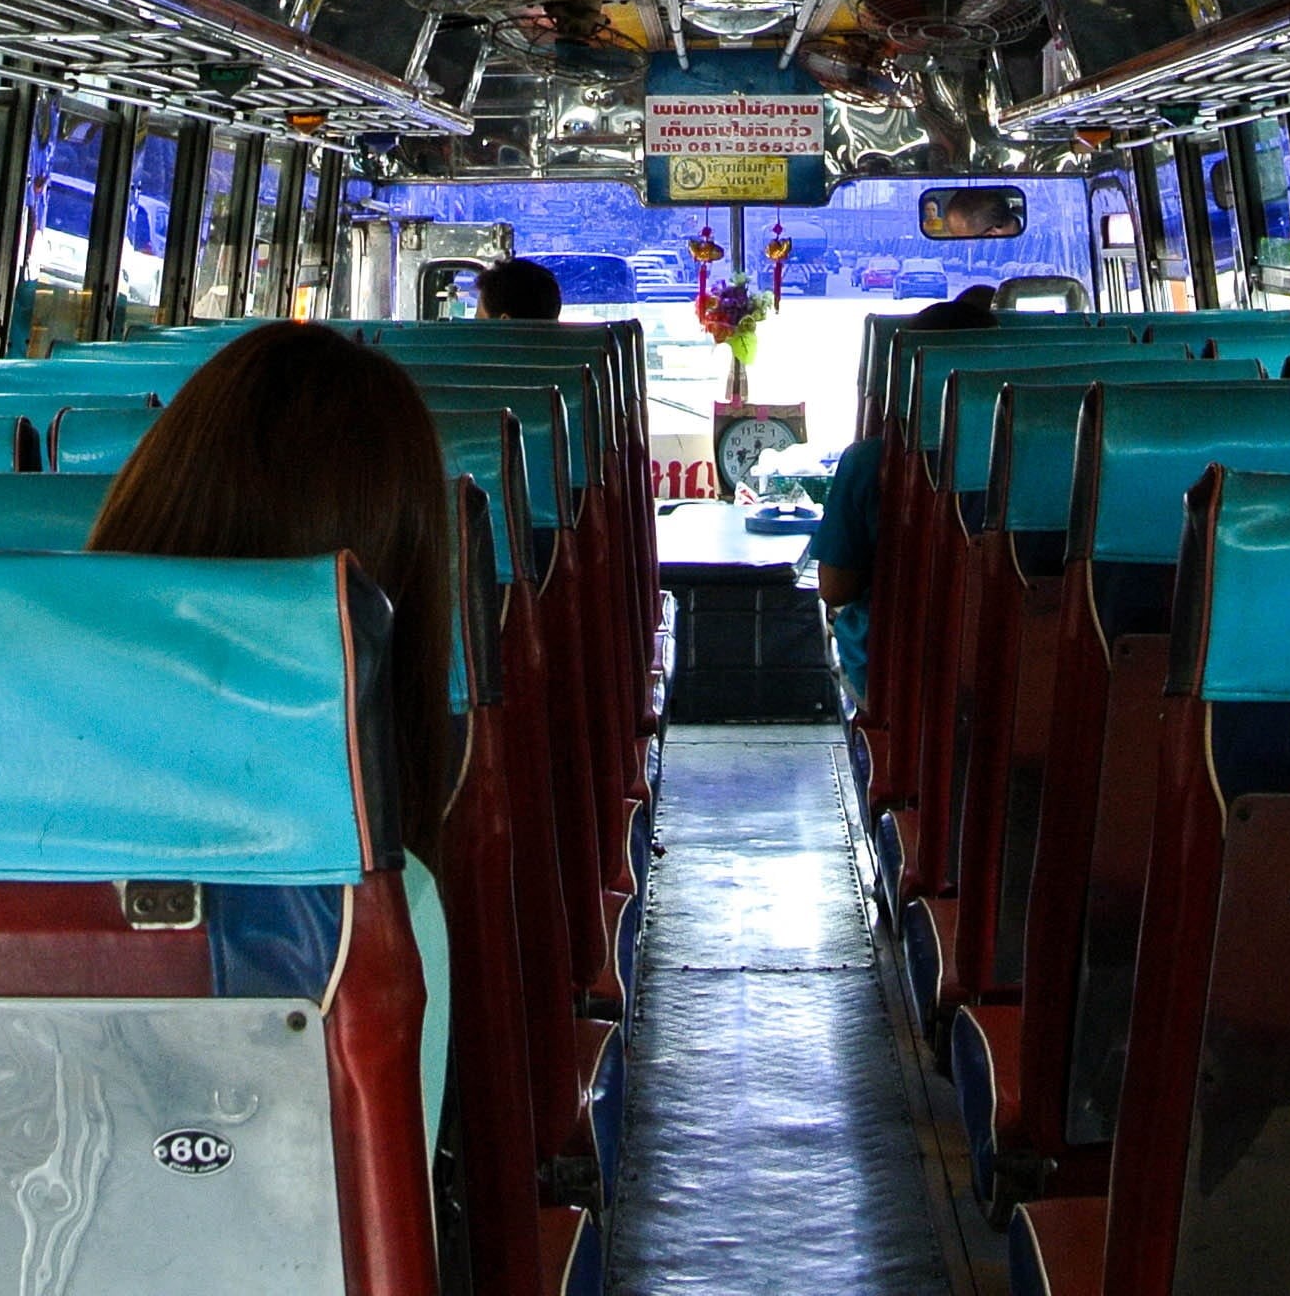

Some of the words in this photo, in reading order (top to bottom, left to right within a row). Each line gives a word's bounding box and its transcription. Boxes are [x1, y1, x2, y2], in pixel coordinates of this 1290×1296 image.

[653, 99, 819, 118] พนักงานไม่สุภาพ
[651, 138, 682, 152] แจ้ง
[741, 426, 751, 436] 11
[754, 423, 765, 433] 12
[731, 437, 741, 446] 10
[170, 1136, 217, 1162] 60
